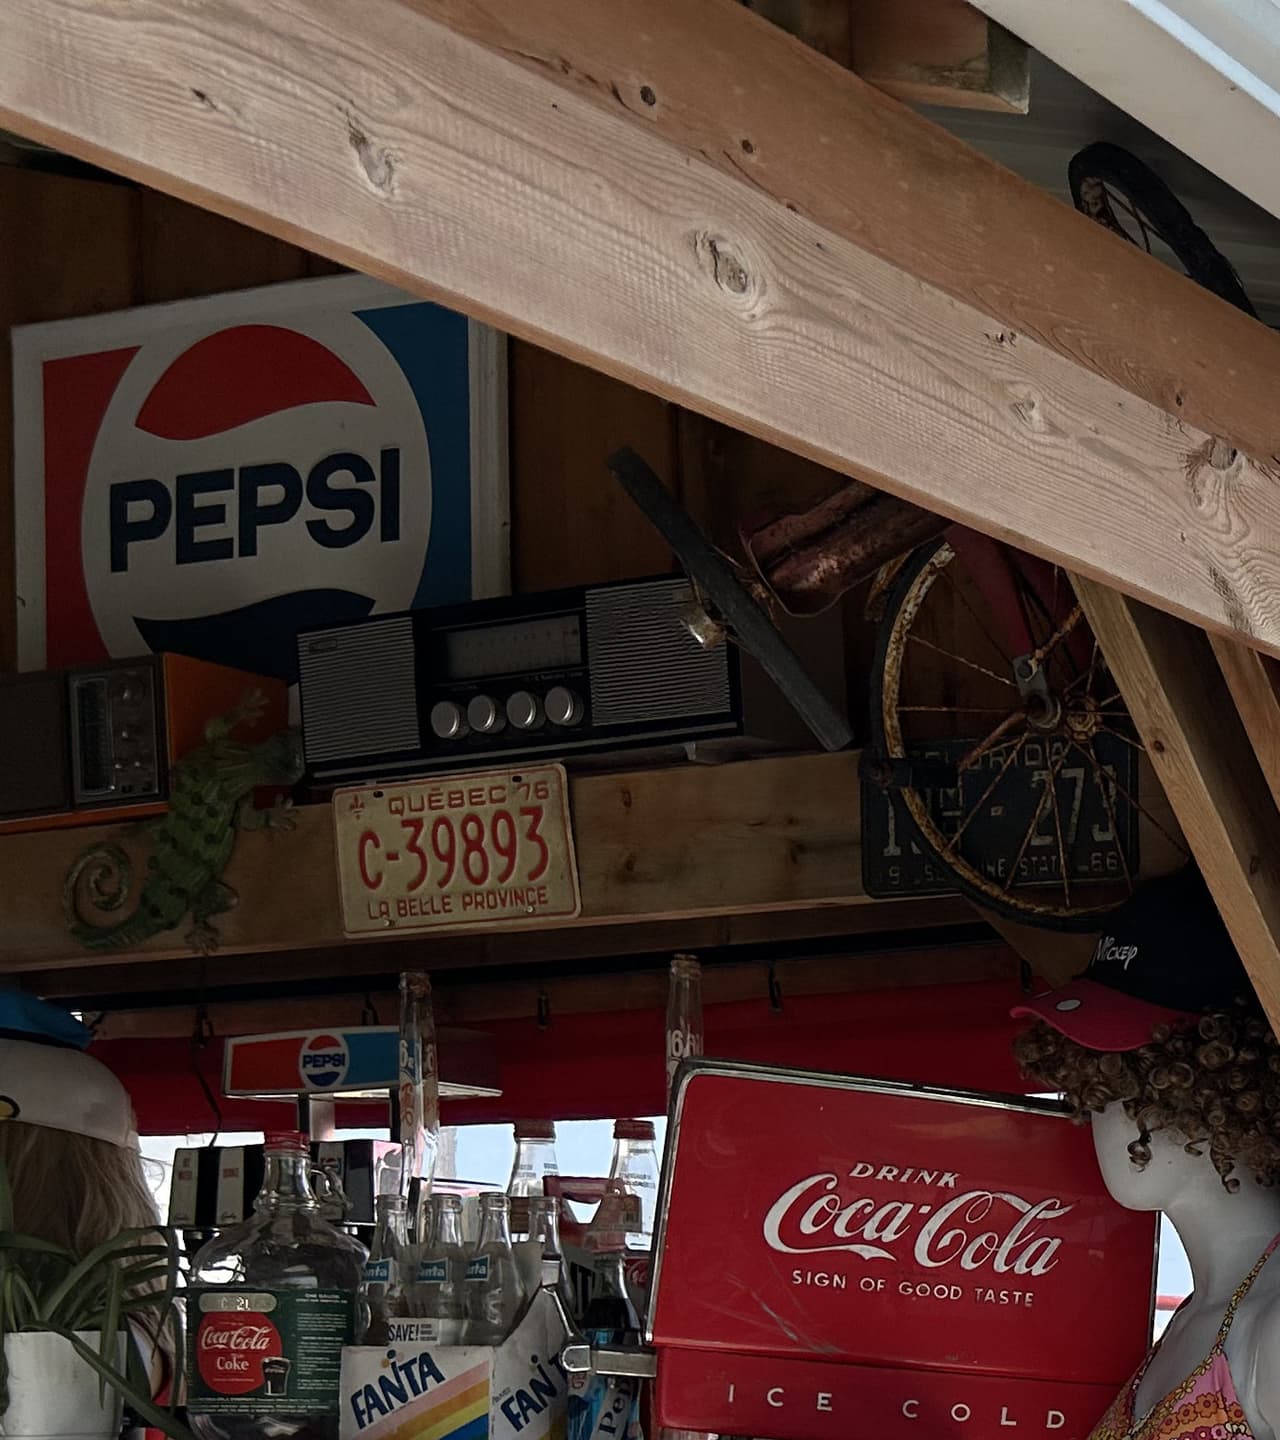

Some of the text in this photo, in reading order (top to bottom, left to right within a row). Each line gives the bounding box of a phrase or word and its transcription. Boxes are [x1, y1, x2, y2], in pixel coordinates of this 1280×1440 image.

[110, 448, 400, 573] PEPSI
[359, 805, 549, 892] C-39893
[368, 886, 549, 921] LA BELLE PROVINCE
[303, 1053, 346, 1069] PEPSI
[847, 1161, 962, 1190] DRINK
[762, 1172, 1076, 1278] Coca-Cola
[791, 1269, 1036, 1308] SIGN OF GOOD TASTE
[388, 1323, 419, 1342] SAVE!
[216, 1356, 250, 1371] Coke
[350, 1350, 446, 1431] FANTA
[727, 1383, 1067, 1430] ICE COLD
